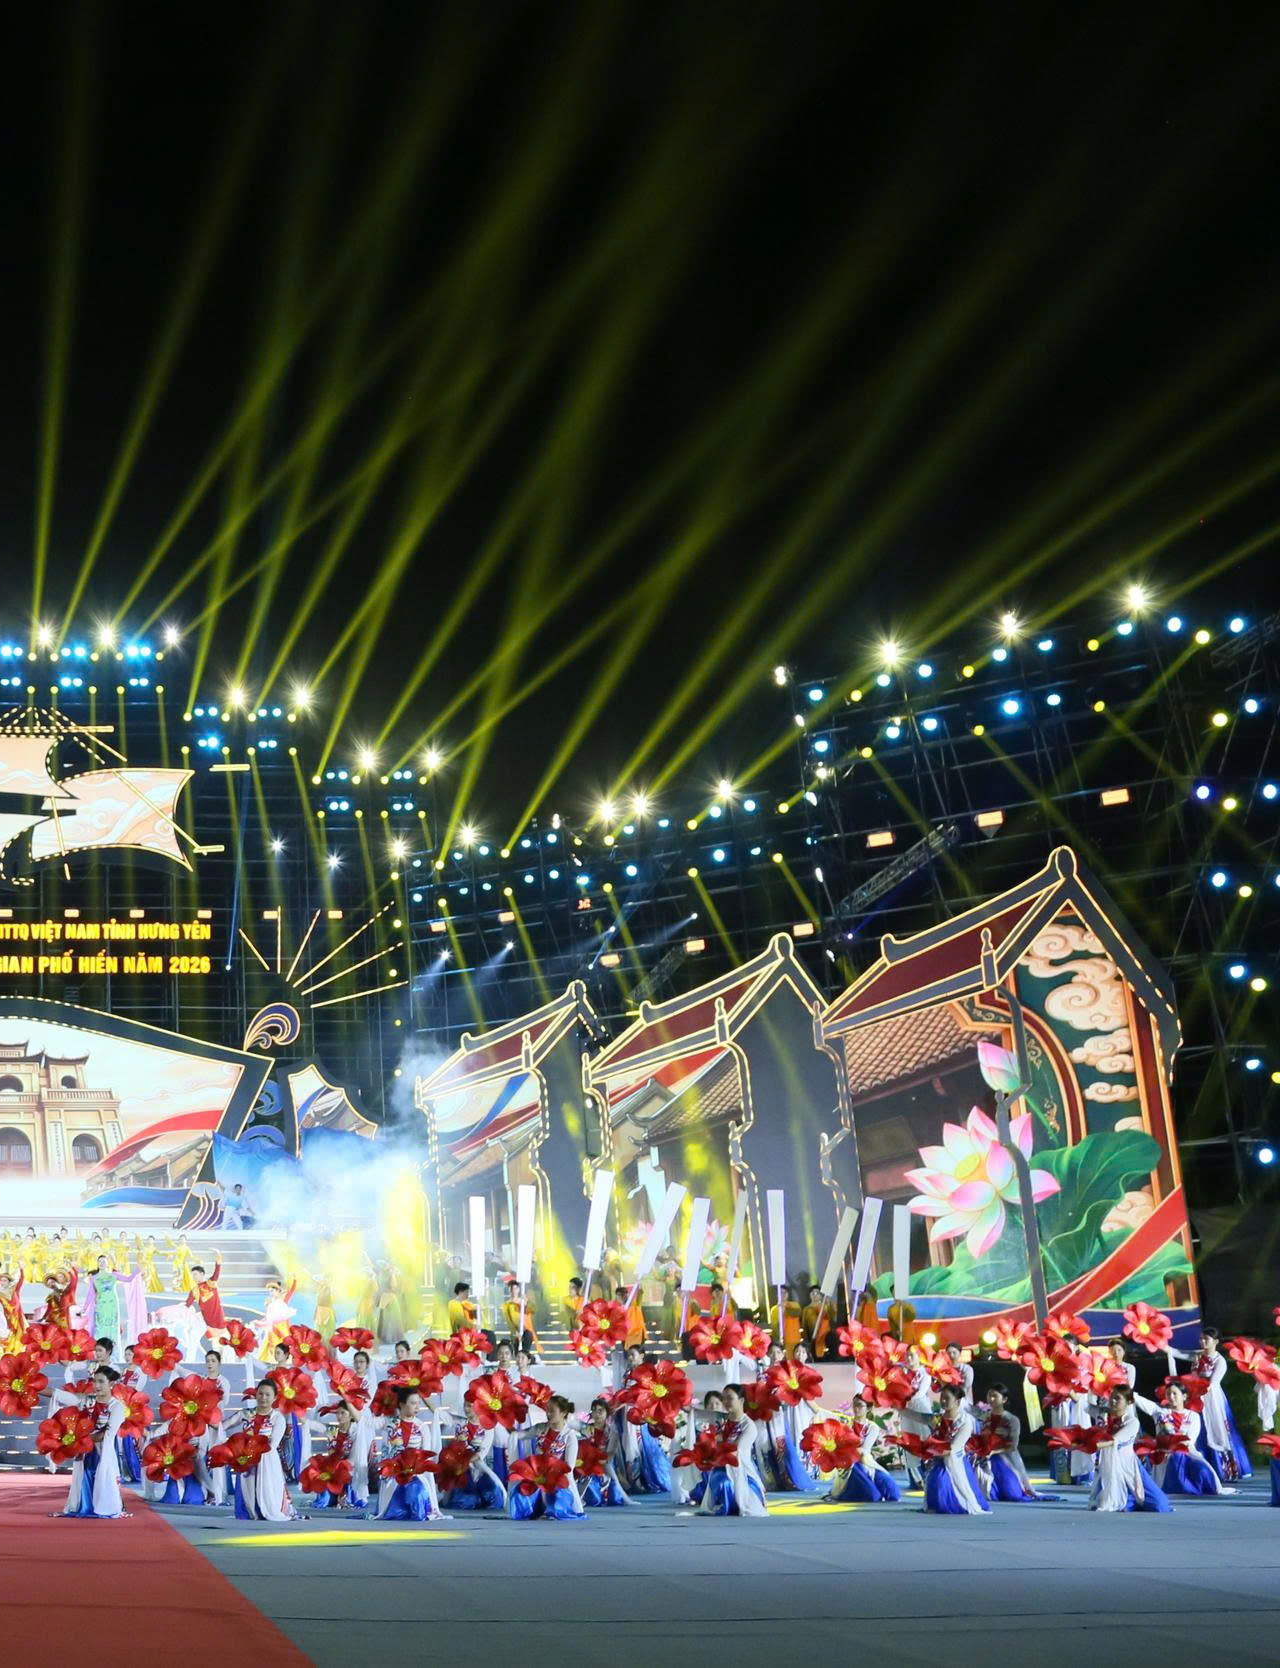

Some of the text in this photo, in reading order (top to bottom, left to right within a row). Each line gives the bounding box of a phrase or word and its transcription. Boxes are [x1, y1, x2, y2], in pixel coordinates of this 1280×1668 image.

[30, 919, 63, 943] VIỆT
[65, 923, 100, 940] NAM
[102, 918, 136, 940] TỈNH
[138, 921, 179, 940] HƯNG
[182, 919, 211, 940] YÊN
[38, 948, 74, 974] PHỐ
[78, 948, 118, 974] HIẾN
[123, 951, 163, 974] NĂM
[168, 955, 211, 974] 2026
